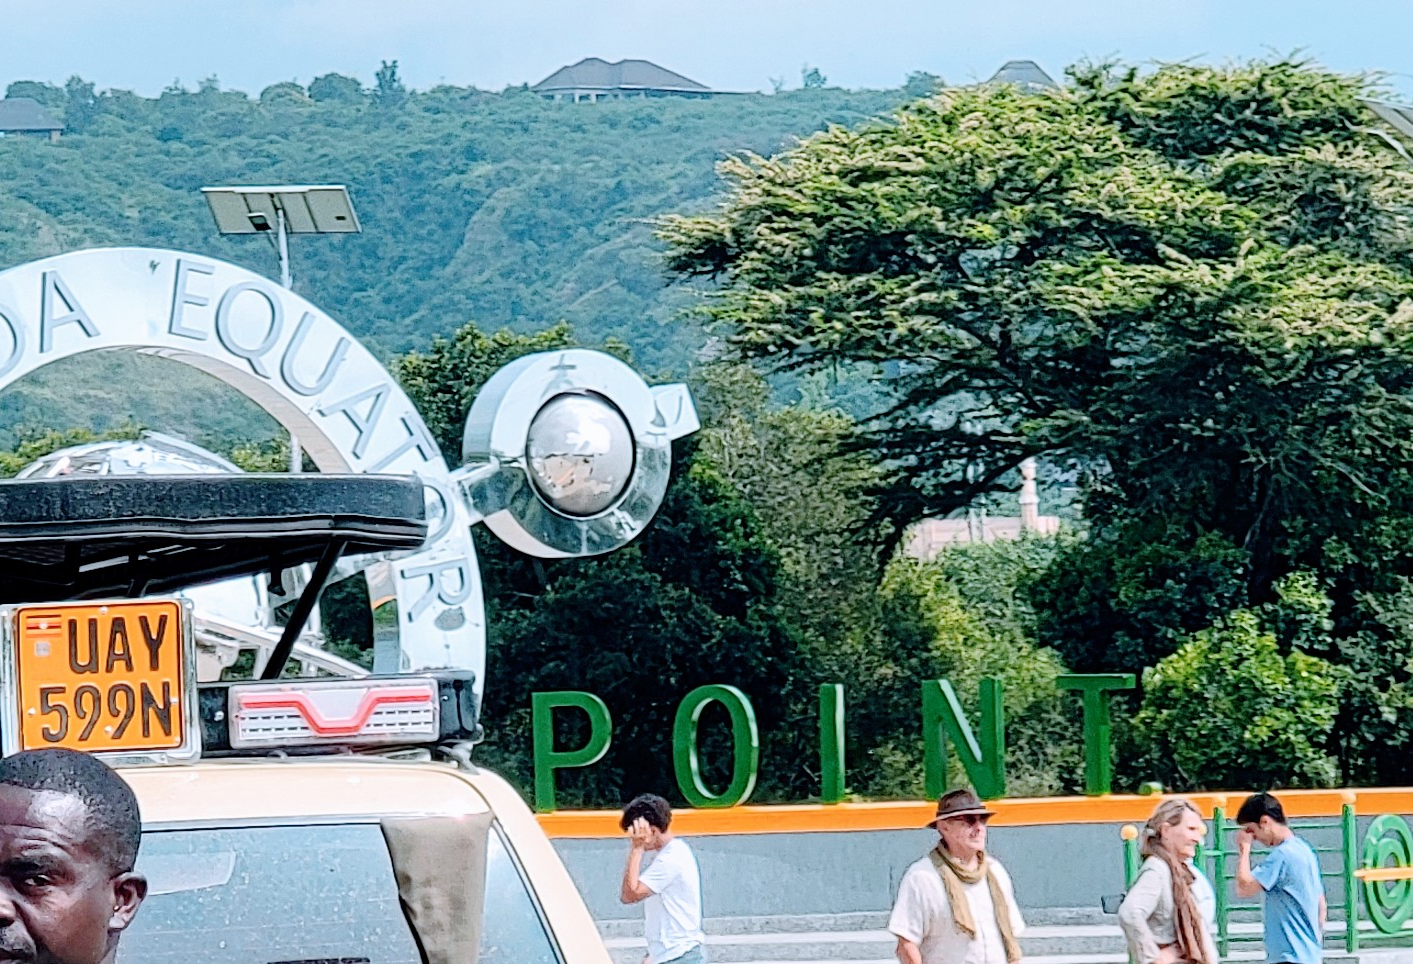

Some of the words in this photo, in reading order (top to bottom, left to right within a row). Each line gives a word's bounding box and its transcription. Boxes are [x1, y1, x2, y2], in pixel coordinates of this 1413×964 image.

[67, 614, 169, 674] UAY
[39, 681, 173, 743] 599N
[532, 672, 1136, 812] POINT
